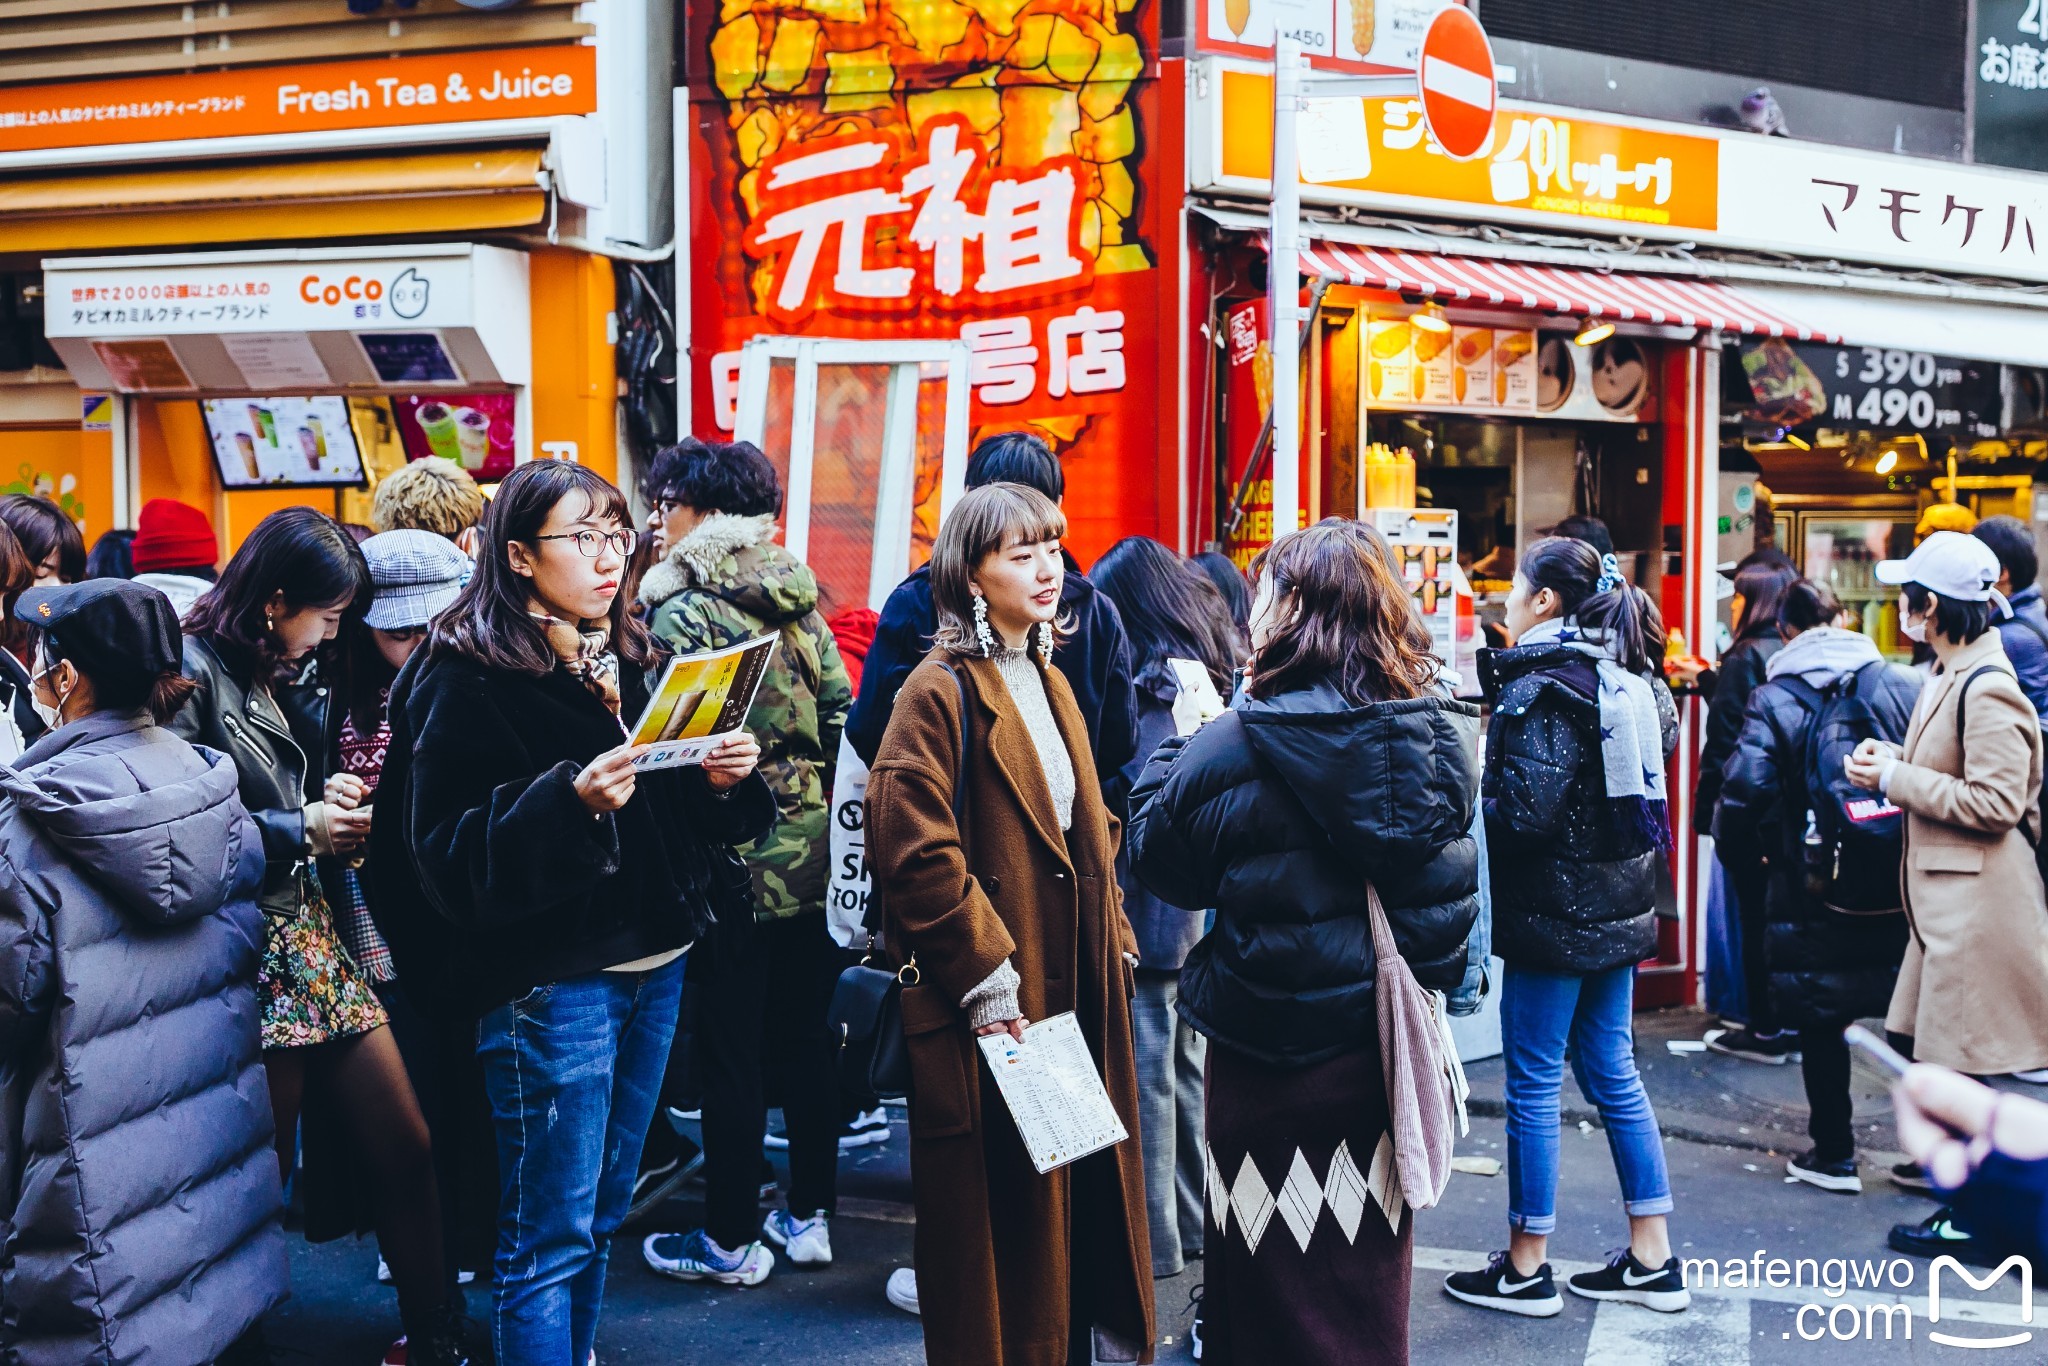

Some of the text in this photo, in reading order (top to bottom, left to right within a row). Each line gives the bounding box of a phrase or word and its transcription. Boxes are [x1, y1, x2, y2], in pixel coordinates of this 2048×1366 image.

[278, 68, 572, 114] Fresh Tea & Juice
[755, 124, 1082, 309] 元祖
[1836, 350, 1849, 379] S
[1859, 346, 1936, 387] 390
[1833, 393, 1852, 421] M
[1856, 387, 1935, 429] 490
